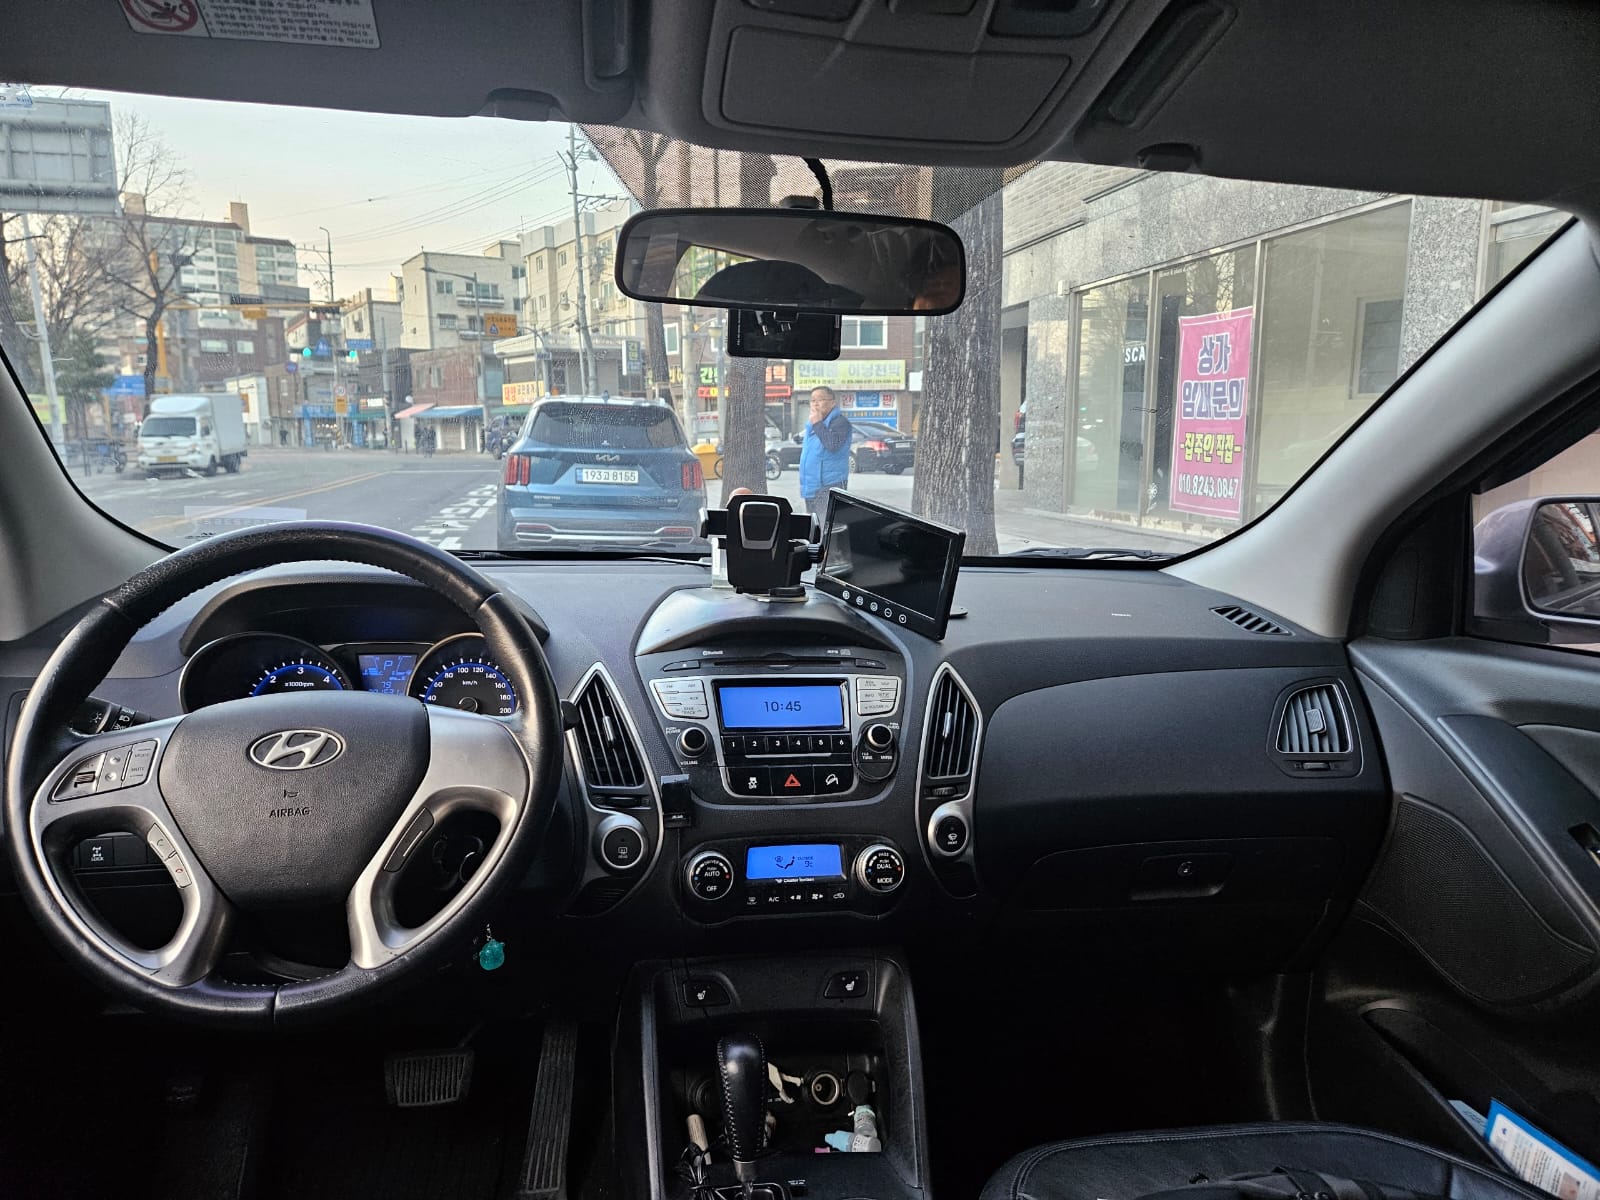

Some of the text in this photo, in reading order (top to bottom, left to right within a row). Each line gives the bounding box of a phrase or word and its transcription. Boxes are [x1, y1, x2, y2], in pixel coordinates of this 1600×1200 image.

[1196, 332, 1232, 376] 상가
[1181, 377, 1246, 420] 임대문의
[612, 472, 636, 482] 8155
[1178, 473, 1239, 500] 010.8243.0847
[297, 667, 304, 675] 3
[383, 660, 394, 671] P
[269, 676, 277, 684] 2
[763, 700, 802, 712] 10:45
[269, 806, 310, 818] AIRBAG
